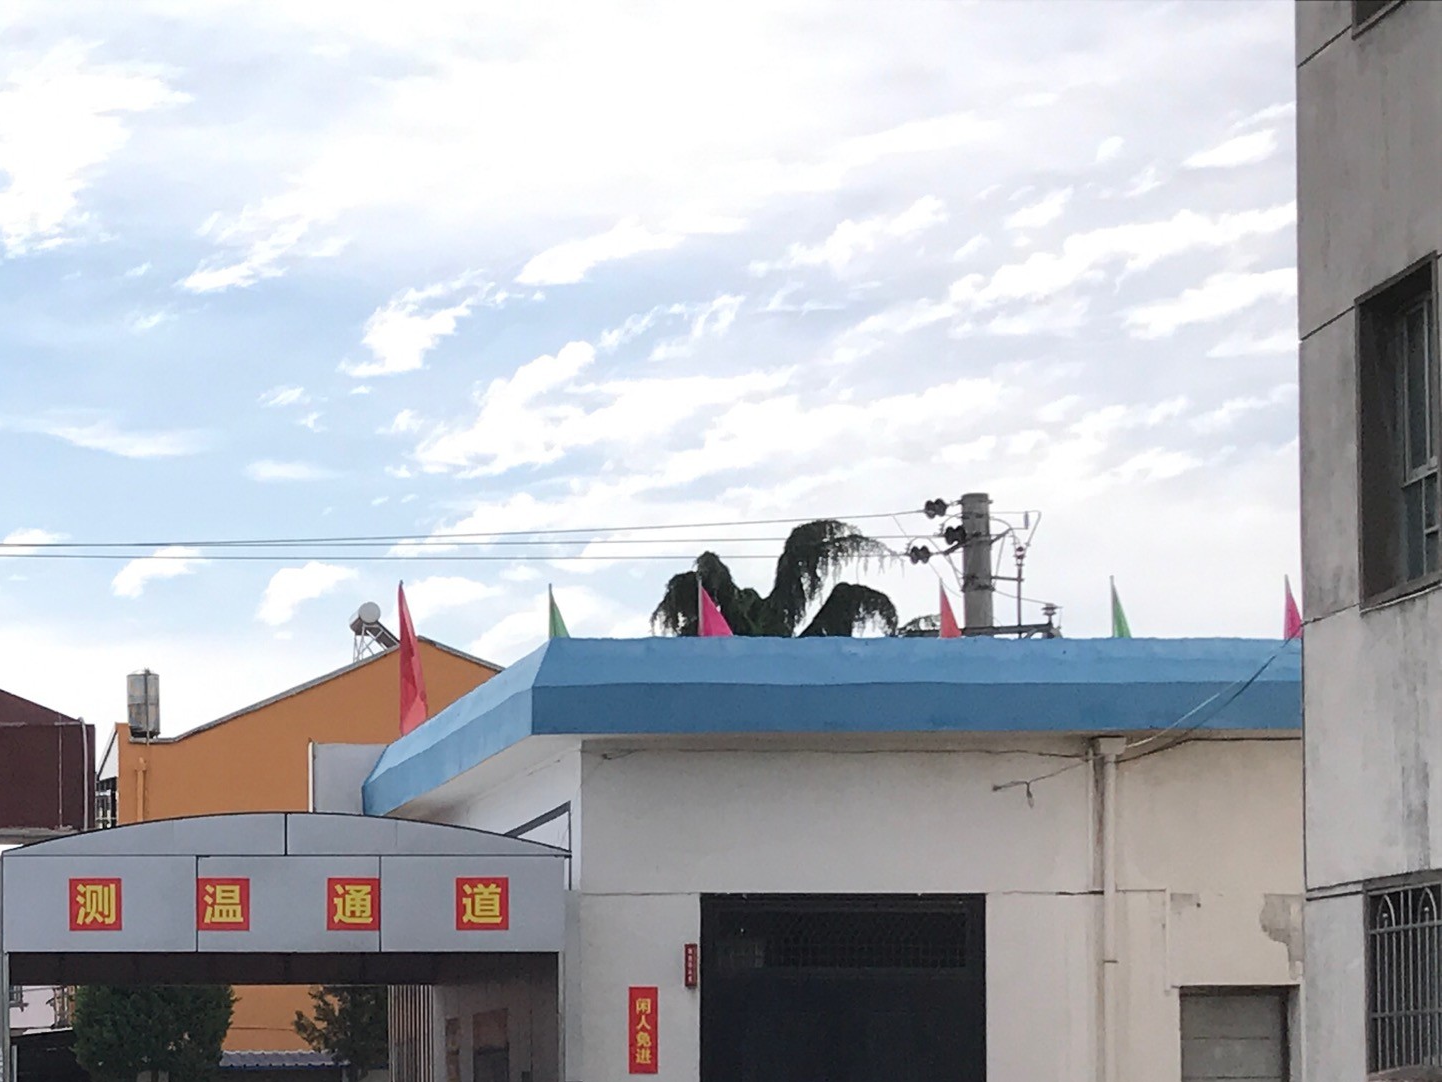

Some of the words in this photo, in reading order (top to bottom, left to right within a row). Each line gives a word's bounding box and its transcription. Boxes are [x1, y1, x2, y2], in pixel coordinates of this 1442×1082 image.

[75, 883, 503, 925] 测温通道
[635, 998, 652, 1064] 闲人免进
